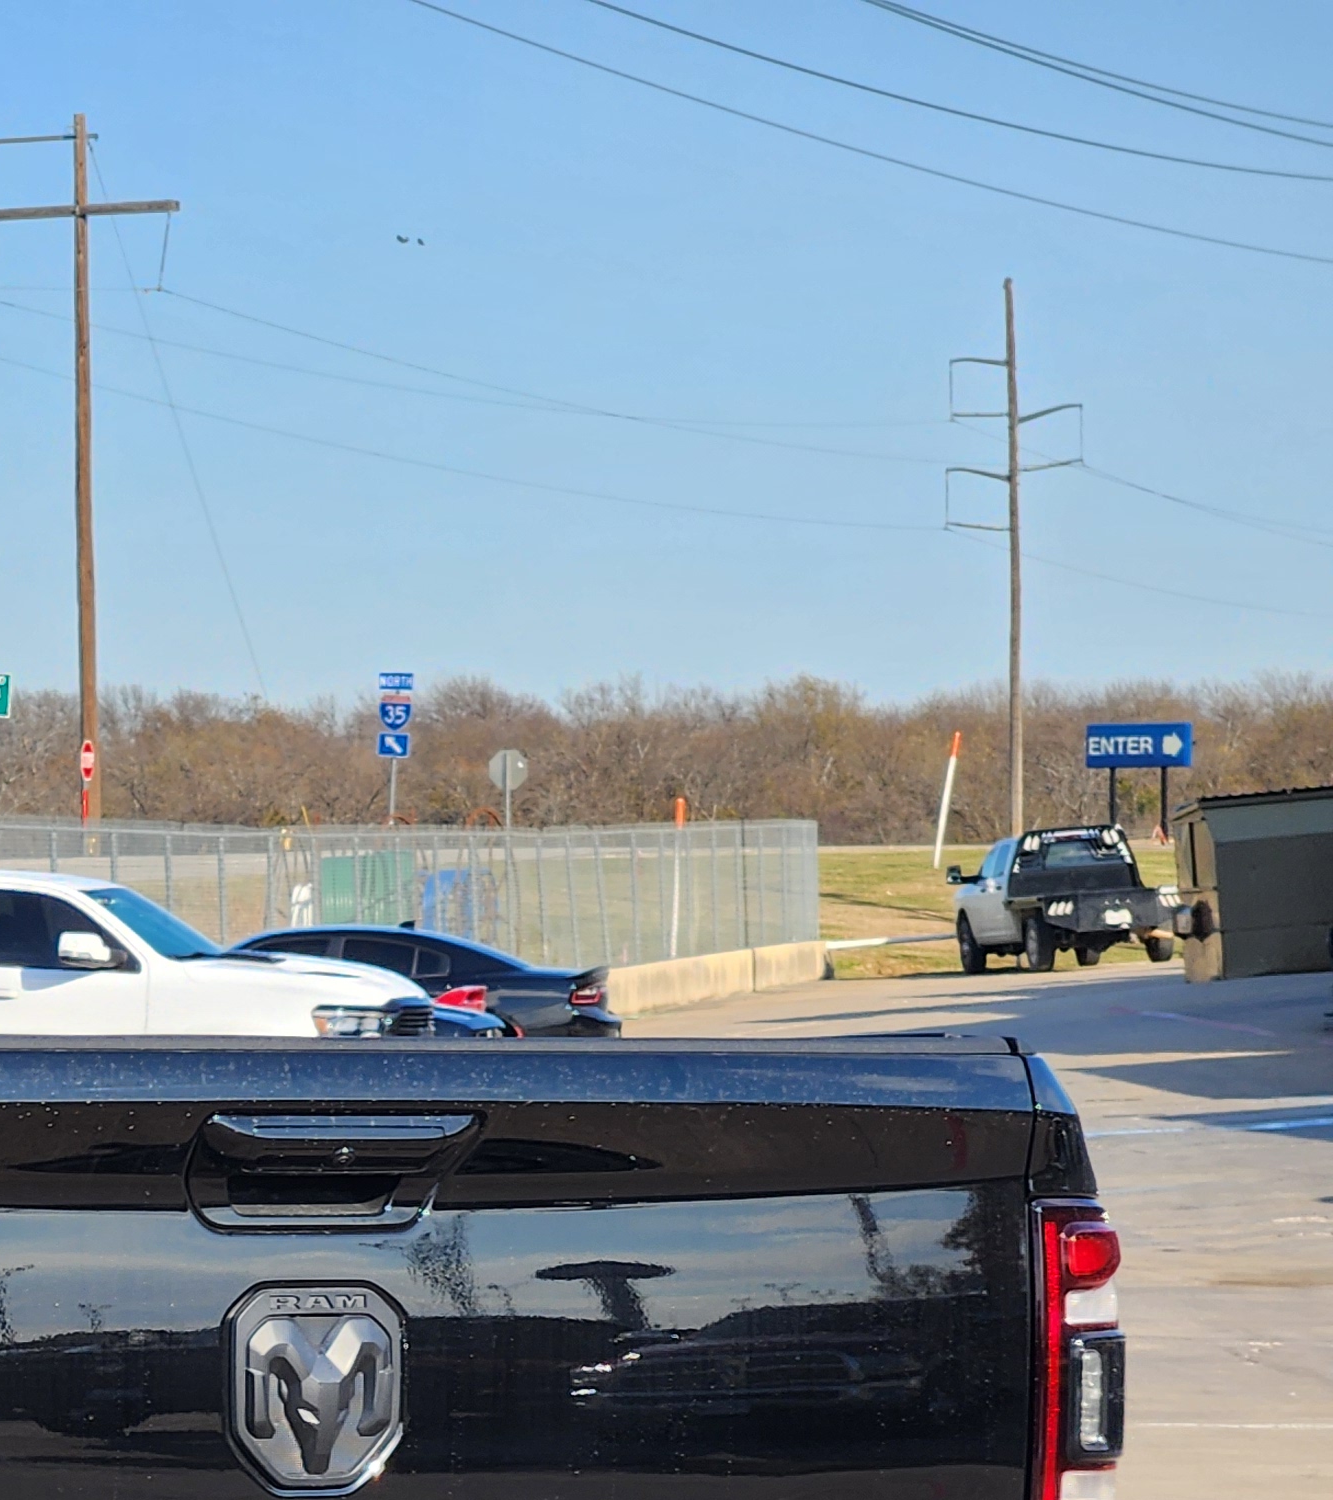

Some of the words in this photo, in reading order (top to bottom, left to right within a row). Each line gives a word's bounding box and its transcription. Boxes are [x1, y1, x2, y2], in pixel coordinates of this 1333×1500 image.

[380, 675, 413, 688] NORTH
[384, 705, 407, 725] 35
[1088, 736, 1153, 755] ENTER
[269, 1293, 367, 1311] RAM
